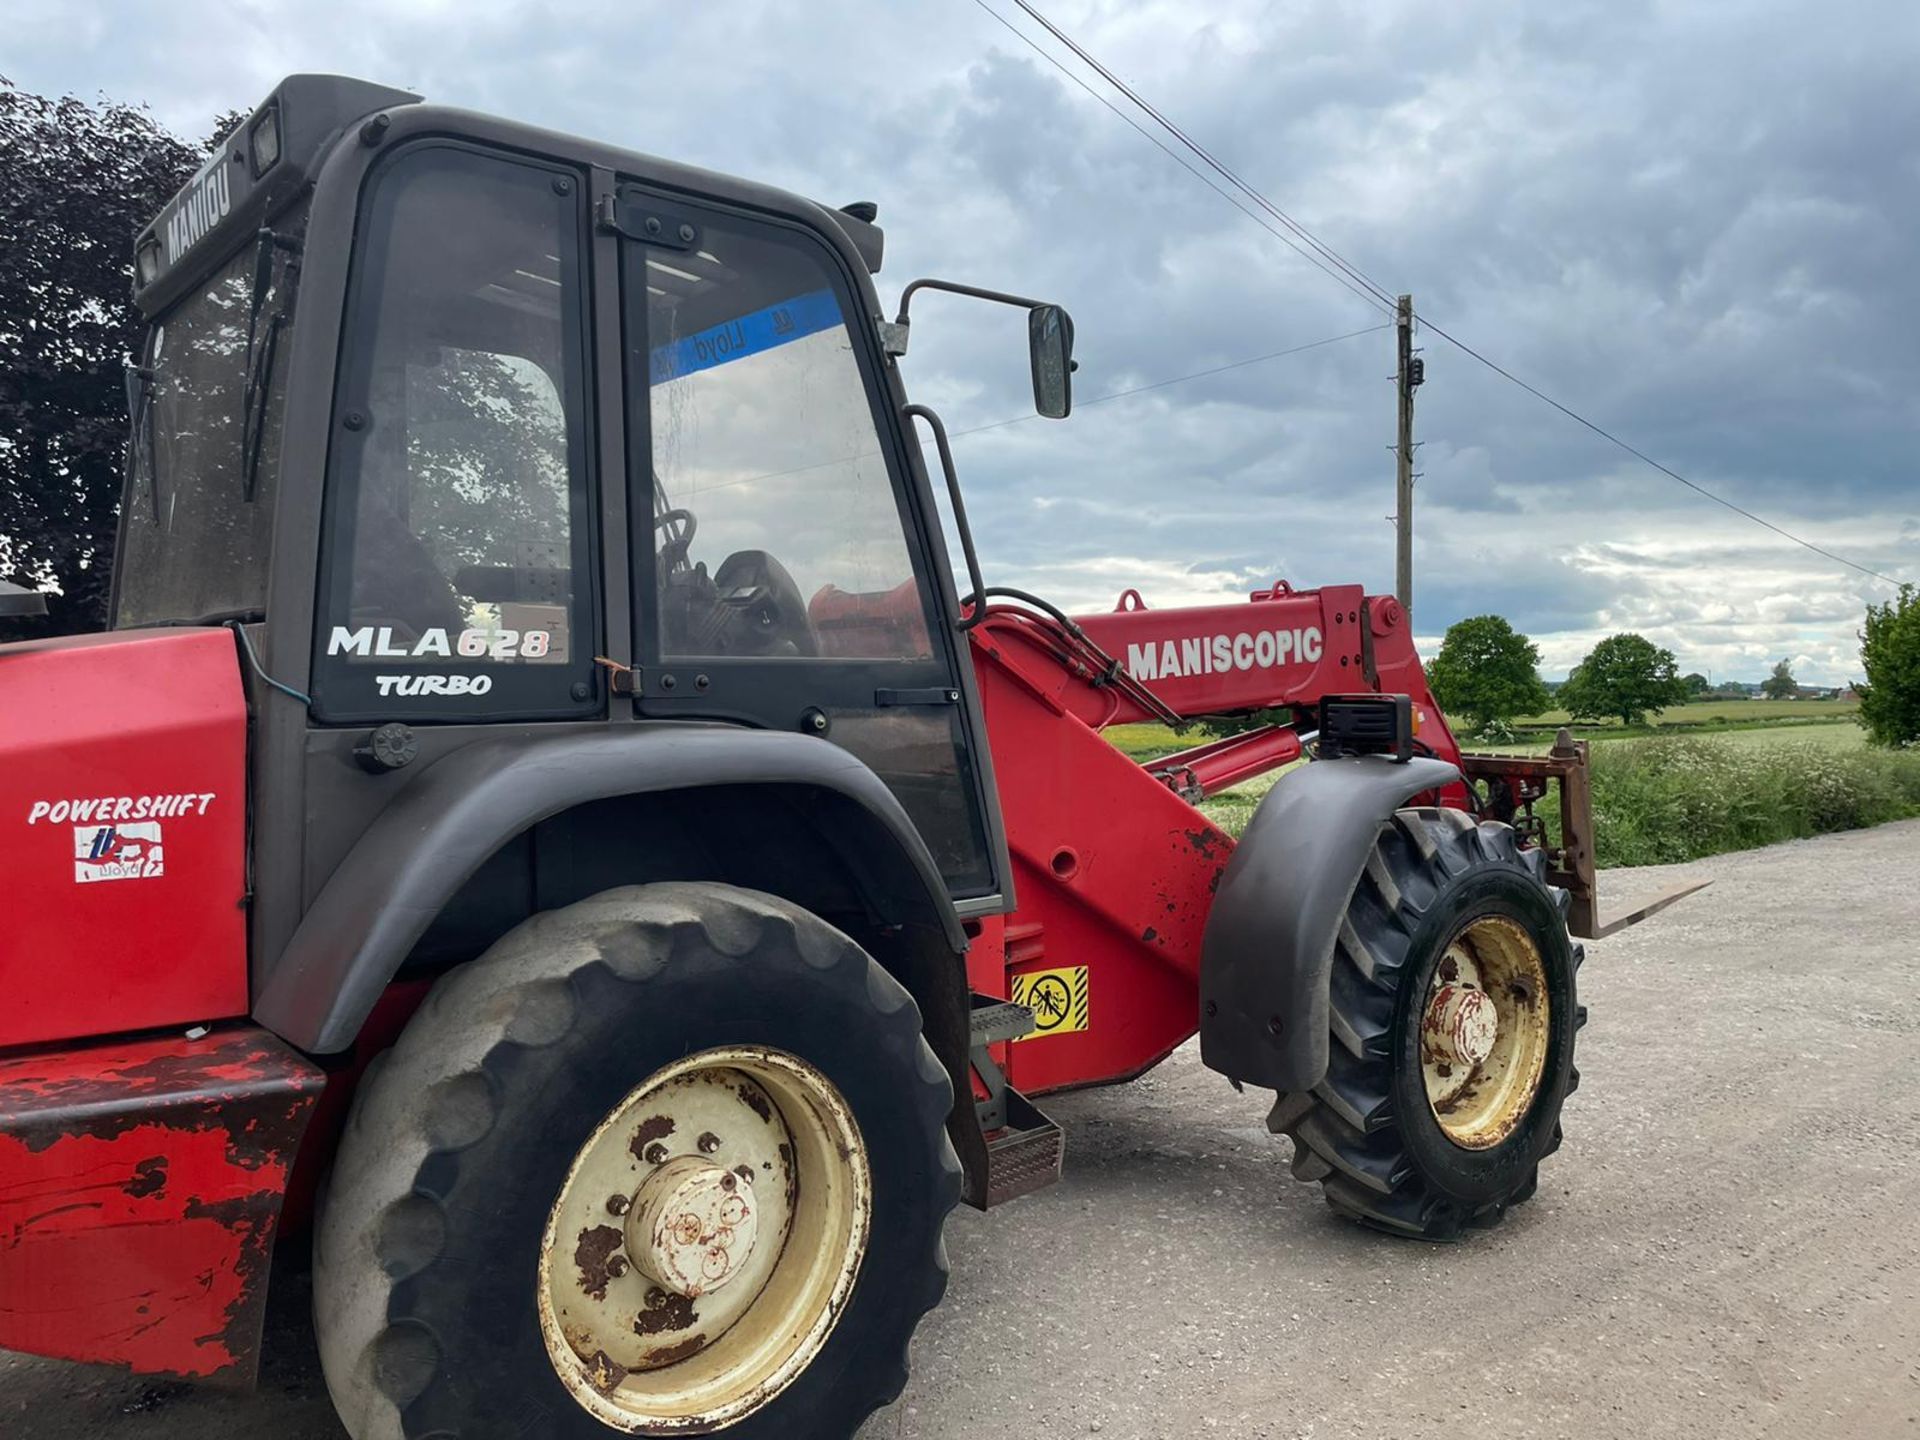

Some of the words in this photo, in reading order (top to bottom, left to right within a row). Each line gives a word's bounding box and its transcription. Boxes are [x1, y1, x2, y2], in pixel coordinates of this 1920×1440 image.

[167, 146, 231, 265] MANITOU
[1127, 626, 1323, 681] MANISCOPIC
[375, 674, 492, 697] TURBO
[27, 792, 216, 825] POWERSHIFT
[99, 862, 139, 877] Lloyd
